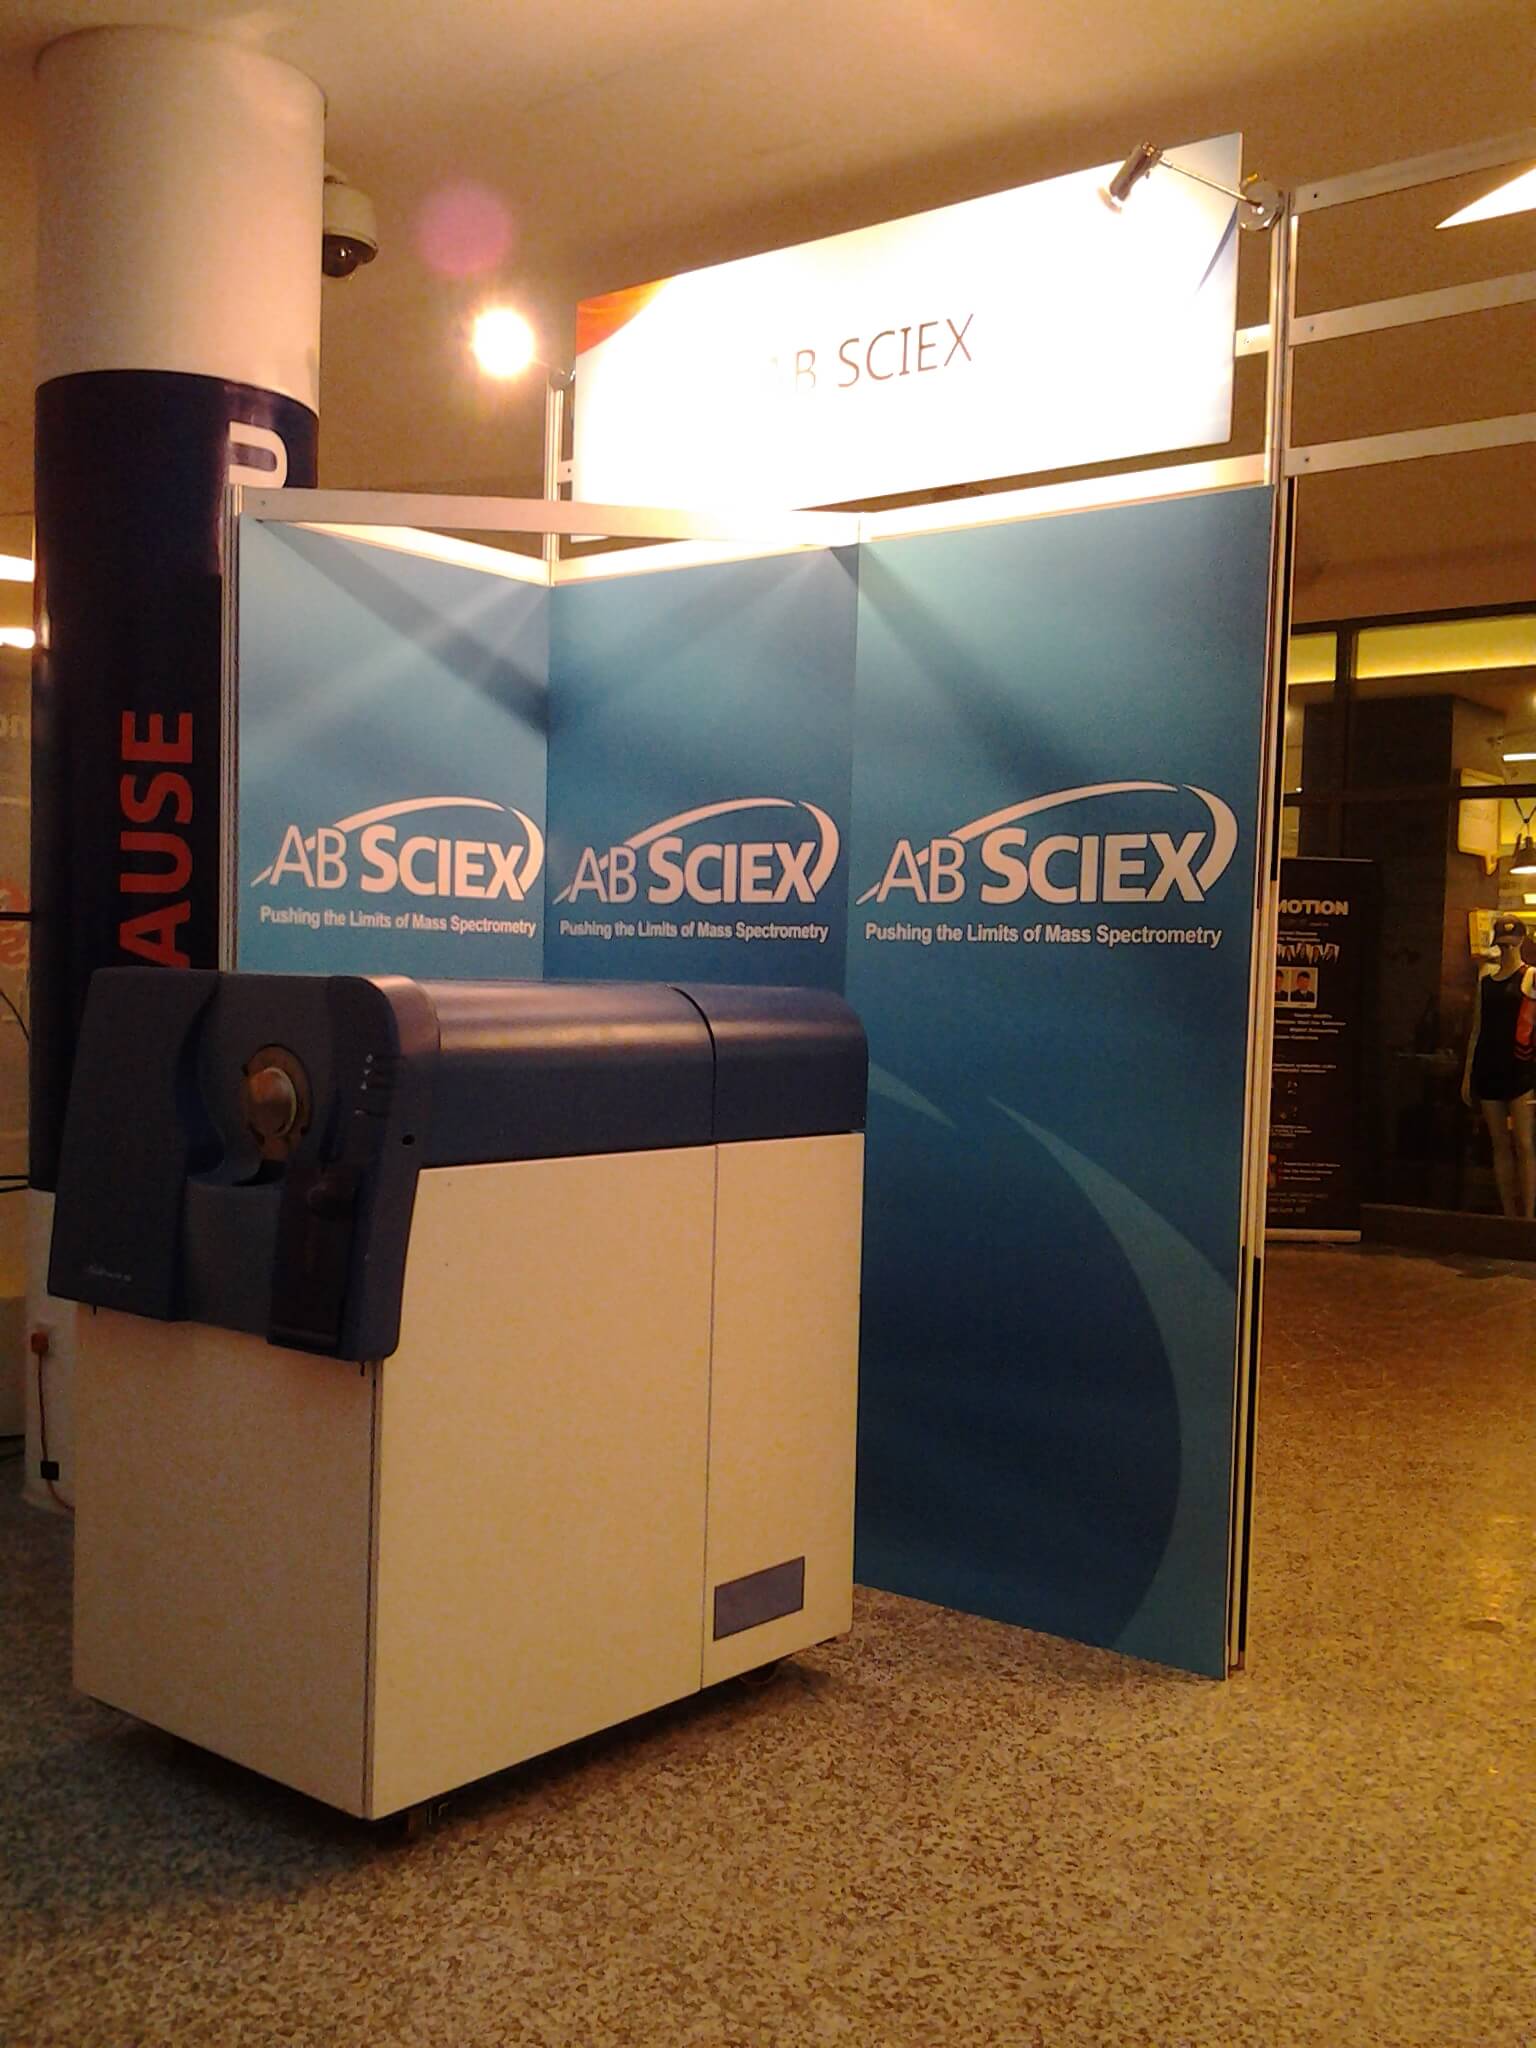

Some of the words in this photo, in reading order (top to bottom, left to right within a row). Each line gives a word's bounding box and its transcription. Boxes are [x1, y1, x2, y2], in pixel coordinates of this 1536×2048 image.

[837, 313, 975, 388] SCIEX
[269, 824, 348, 889] AB
[360, 823, 525, 901] SCIEX
[568, 846, 637, 904] AB
[647, 836, 817, 904] SCIEX
[876, 839, 966, 904] AB
[980, 827, 1206, 904] SCIEX
[259, 905, 321, 929] Pushing
[324, 909, 345, 926] the
[350, 910, 391, 928] Limits
[395, 911, 411, 929] of
[412, 912, 447, 931] Mass
[450, 915, 537, 938] Spectrometry
[559, 919, 612, 940] Pushing
[614, 921, 635, 937] the
[637, 921, 677, 937] Limits
[681, 921, 695, 938] of
[697, 922, 732, 939] Mass
[735, 922, 830, 943] Spectrometry
[865, 922, 932, 945] Pushing
[936, 923, 962, 942] the
[967, 923, 1019, 942] Limits
[1024, 923, 1042, 943] of
[1045, 924, 1091, 943] Mass
[1096, 925, 1223, 948] Spectrometry
